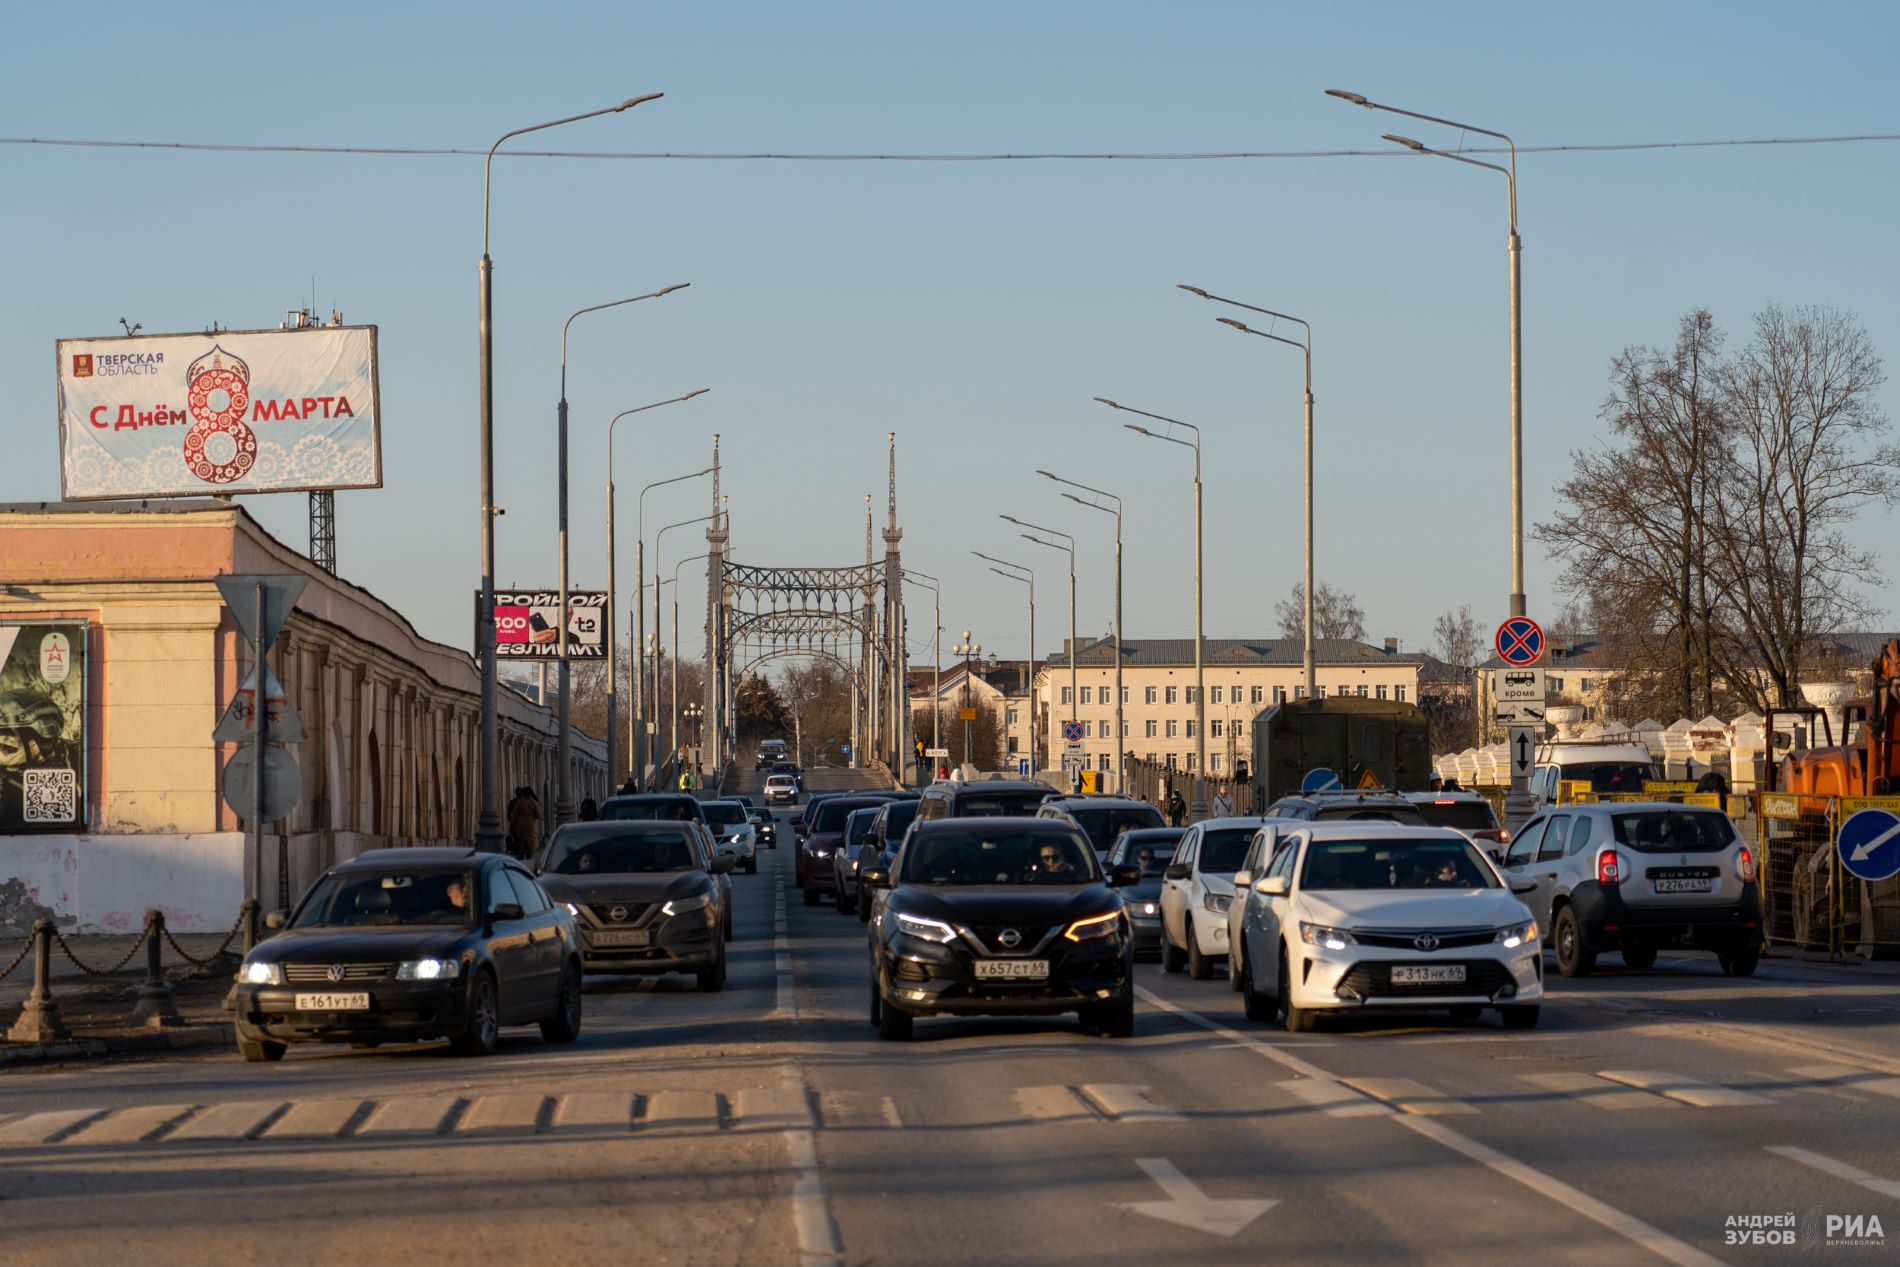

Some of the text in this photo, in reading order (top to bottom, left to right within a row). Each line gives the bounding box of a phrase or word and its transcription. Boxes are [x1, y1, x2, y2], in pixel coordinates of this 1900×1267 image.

[96, 352, 164, 365] ТВЕРСКАЯ
[97, 364, 158, 376] ОБЛАСТЬ
[89, 368, 354, 484] С Днём 8 МАРТА
[1505, 690, 1535, 698] кроме
